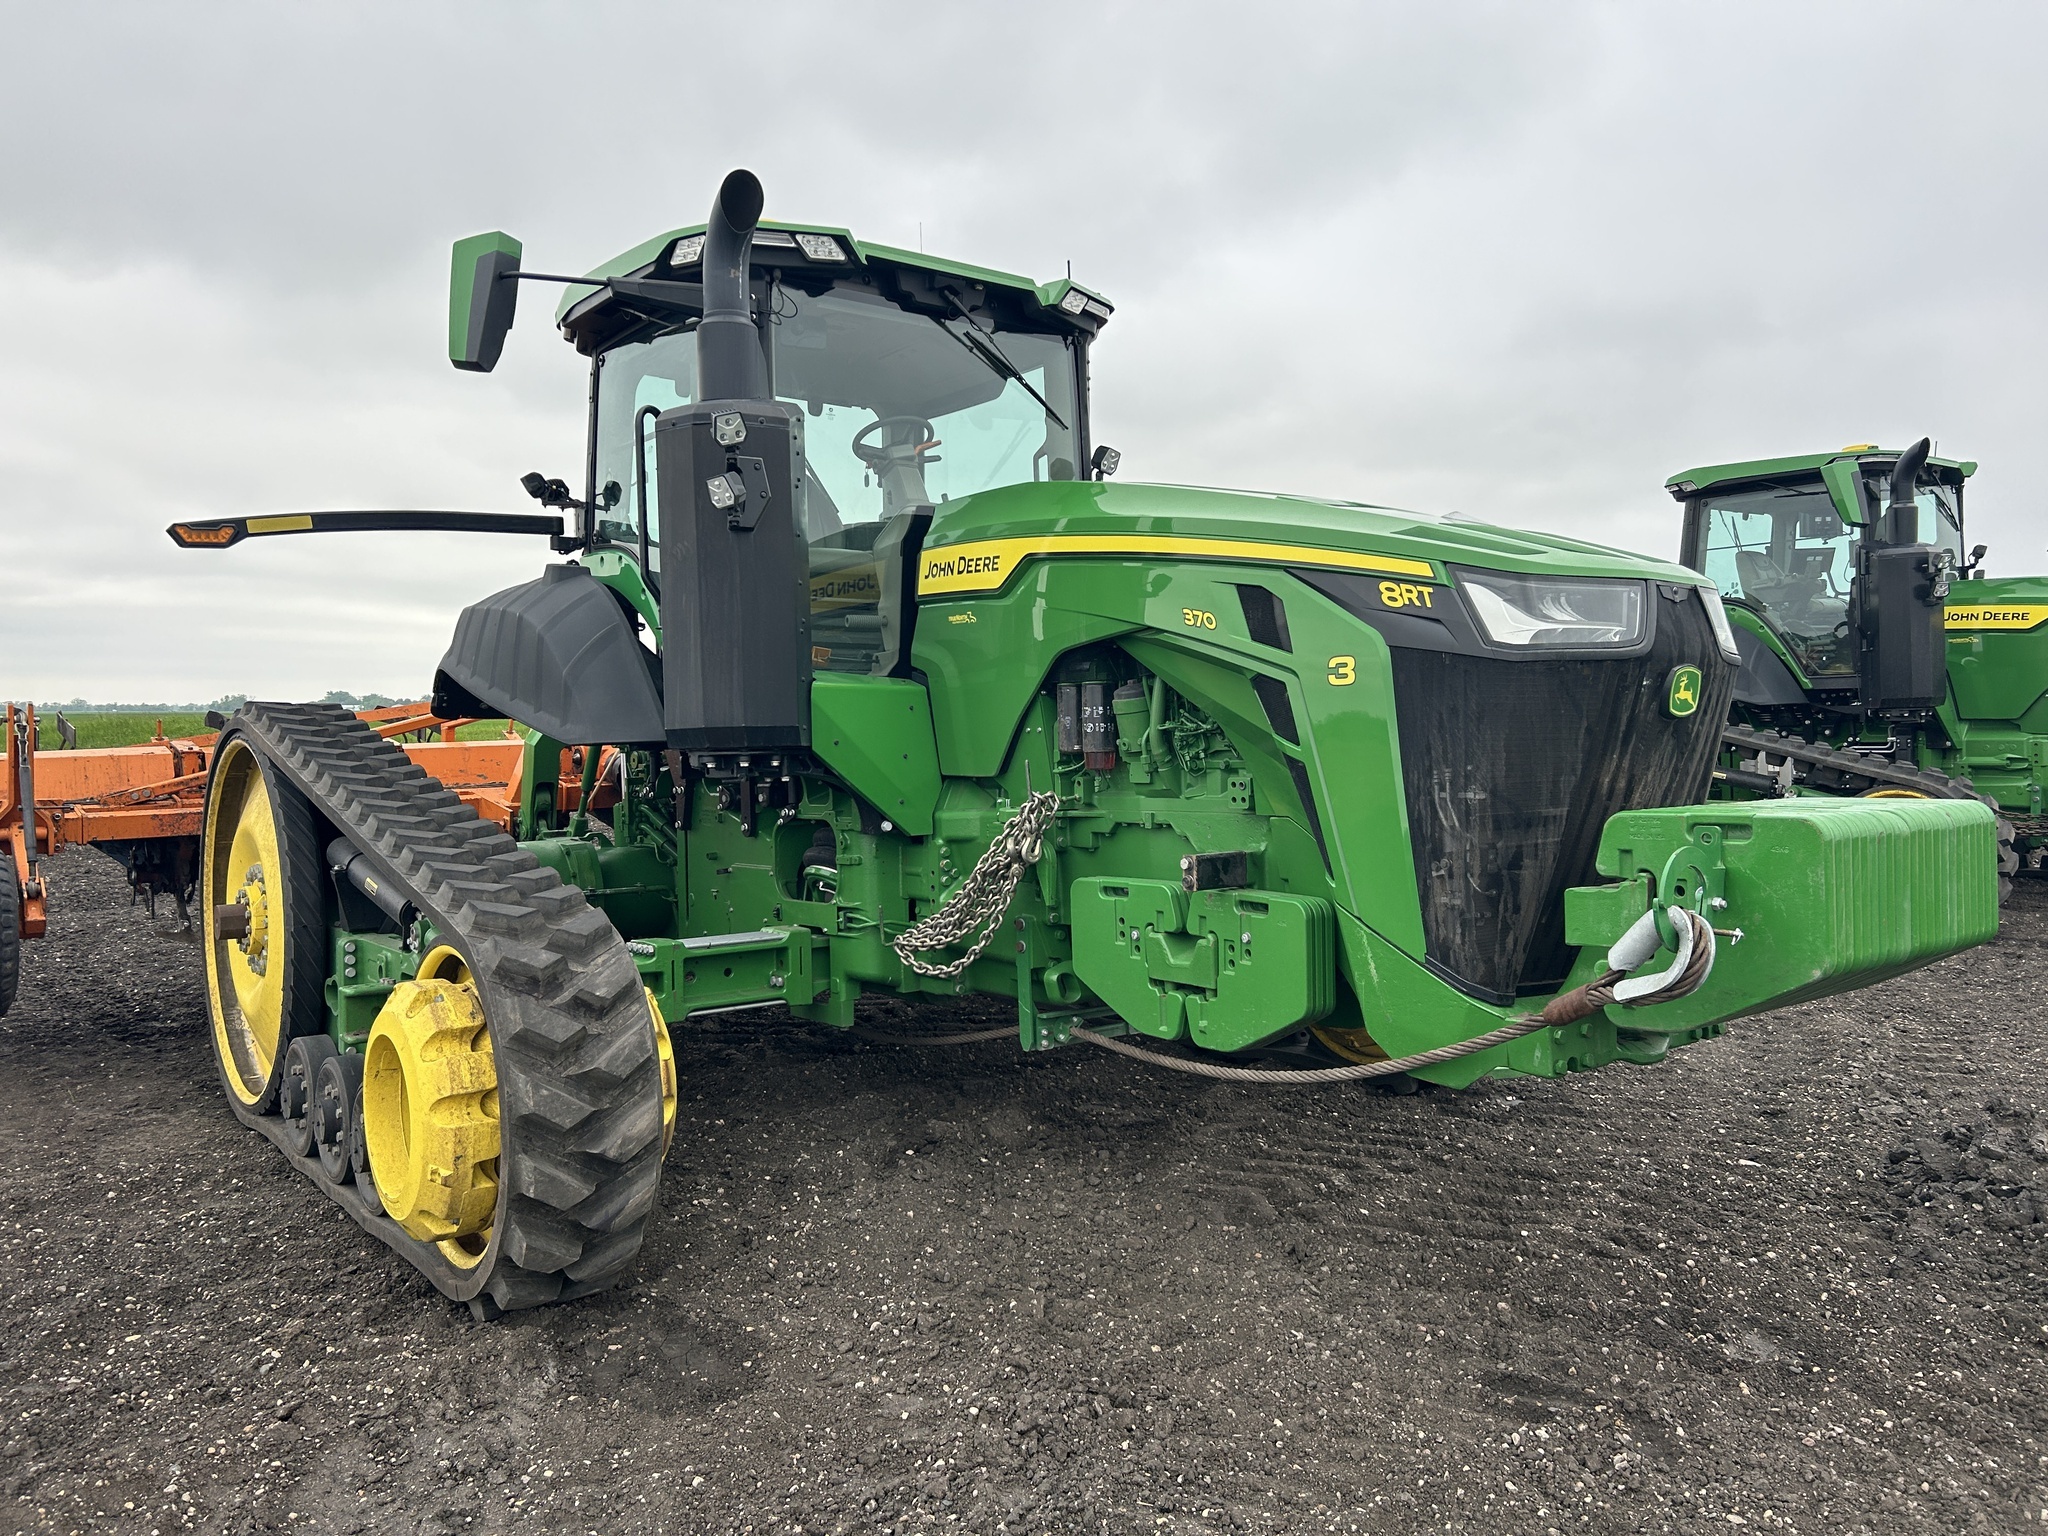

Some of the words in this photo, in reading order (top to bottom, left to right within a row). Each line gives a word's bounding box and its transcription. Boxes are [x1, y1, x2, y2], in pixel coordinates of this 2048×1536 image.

[924, 561, 954, 579] JOHN
[957, 556, 1000, 574] DEERE
[1378, 581, 1434, 608] 8RT
[1182, 608, 1217, 630] 370
[1944, 612, 1979, 621] JOHN
[1983, 611, 2030, 621] DEERE
[1327, 655, 1356, 686] 3
